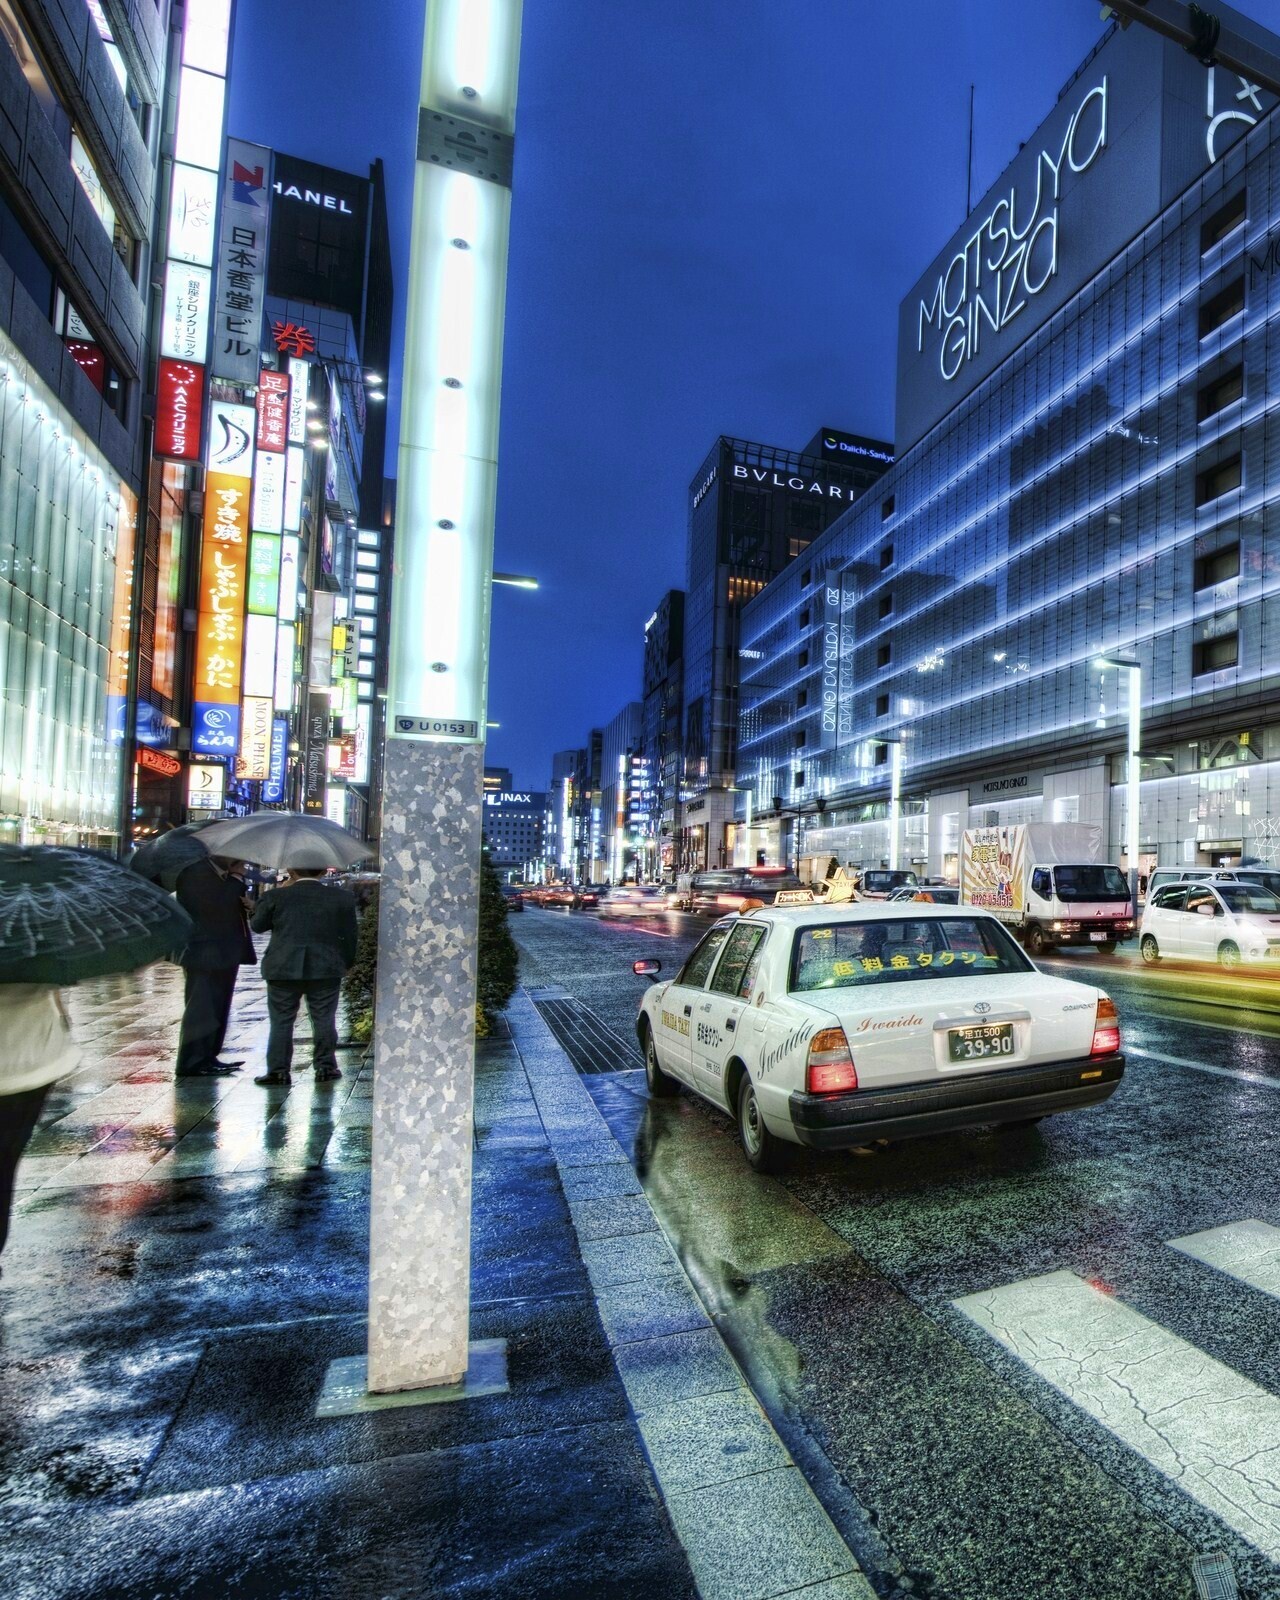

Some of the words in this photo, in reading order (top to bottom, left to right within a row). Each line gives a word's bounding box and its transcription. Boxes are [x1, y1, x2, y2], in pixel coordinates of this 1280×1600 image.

[272, 181, 353, 214] HANEL
[223, 226, 257, 357] 日本香堂ビル
[733, 464, 855, 501] BVLGARI
[253, 700, 268, 737] MOON
[419, 722, 429, 731] U
[433, 723, 466, 734] 0153
[251, 741, 266, 778] PHASE
[500, 792, 531, 803] INAX
[812, 928, 833, 939] 22
[832, 951, 999, 977] 低料金タクシー
[856, 1013, 925, 1033] Iwaida
[964, 1028, 983, 1041] 足立
[983, 1026, 1001, 1037] 500
[757, 1017, 815, 1081] Iwaida
[964, 1036, 1012, 1059] 39-90
